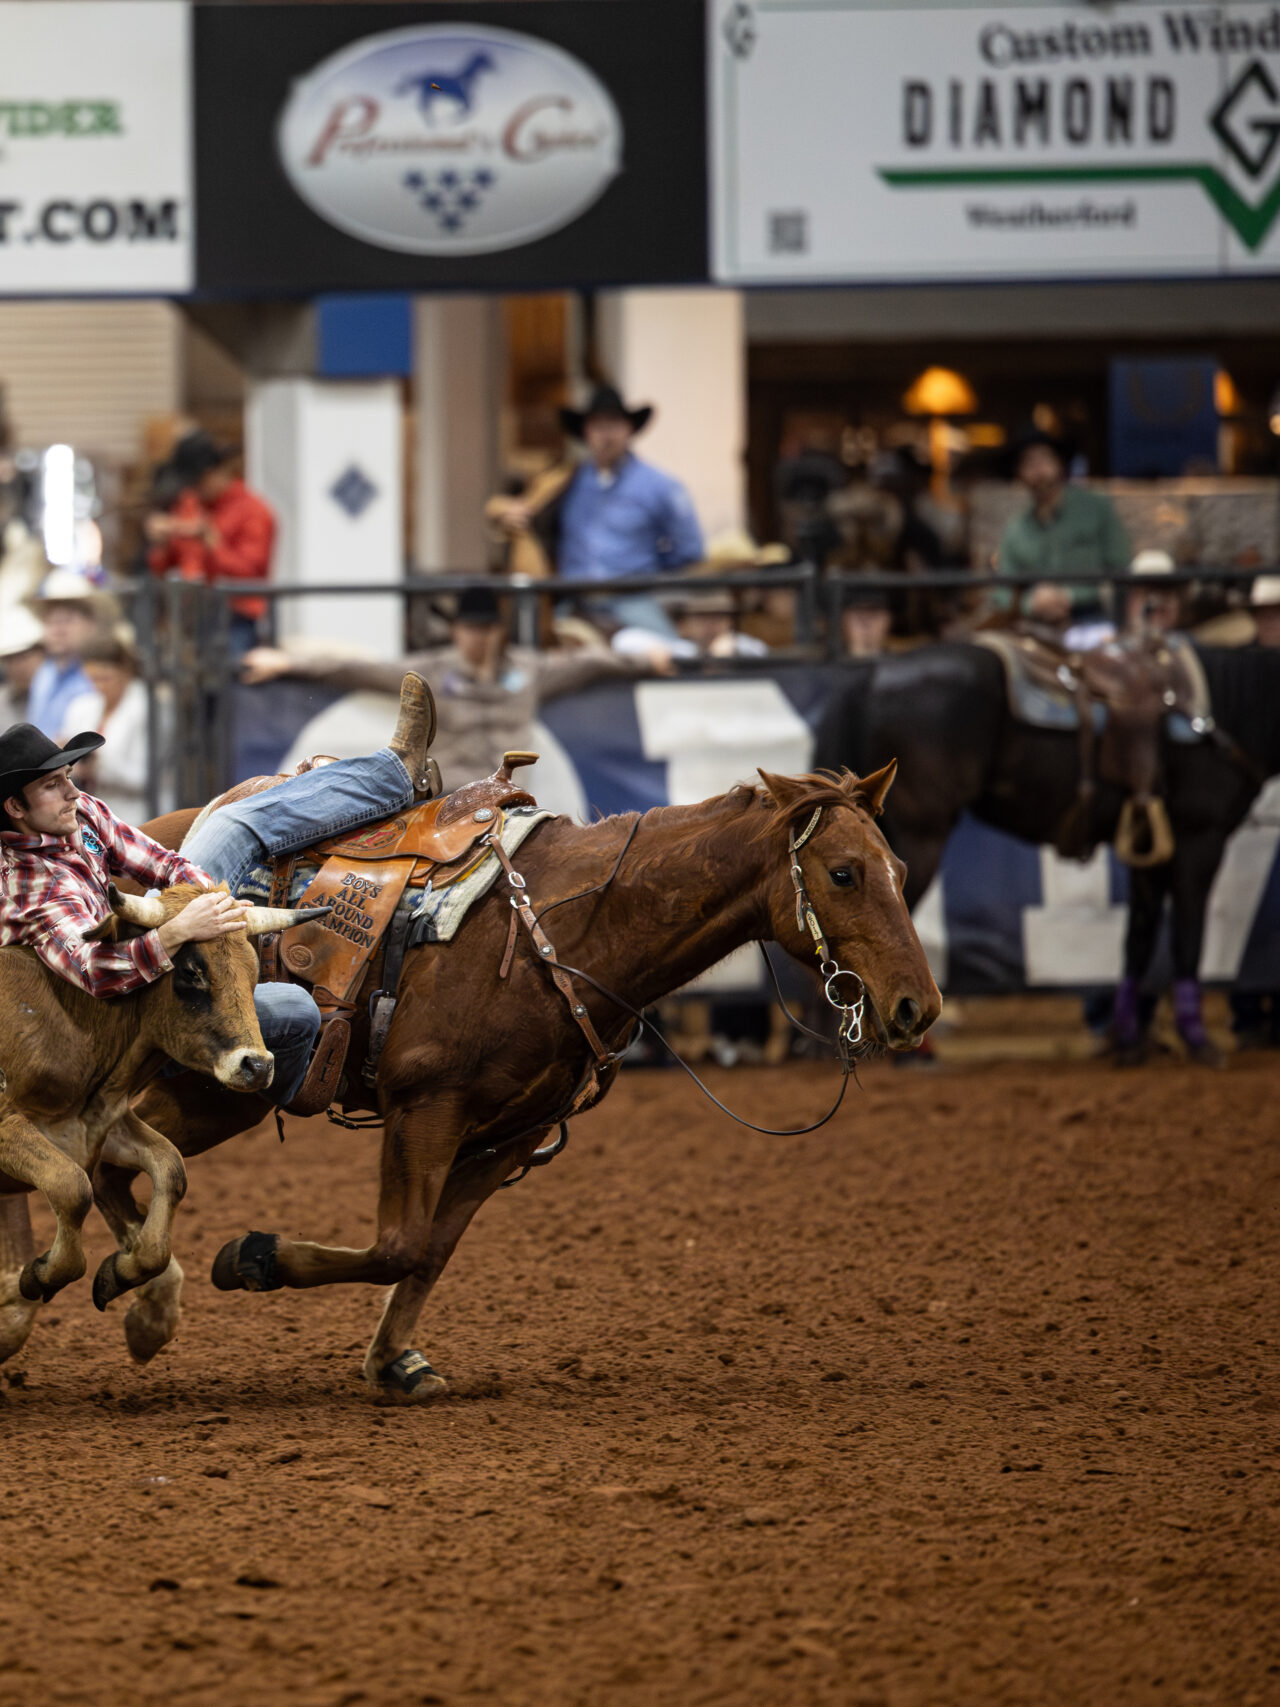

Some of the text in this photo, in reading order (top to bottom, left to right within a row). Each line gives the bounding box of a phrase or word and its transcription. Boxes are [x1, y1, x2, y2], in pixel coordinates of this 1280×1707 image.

[977, 20, 1153, 68] Custom
[902, 73, 1178, 150] DIAMOND
[336, 887, 368, 911] ALL
